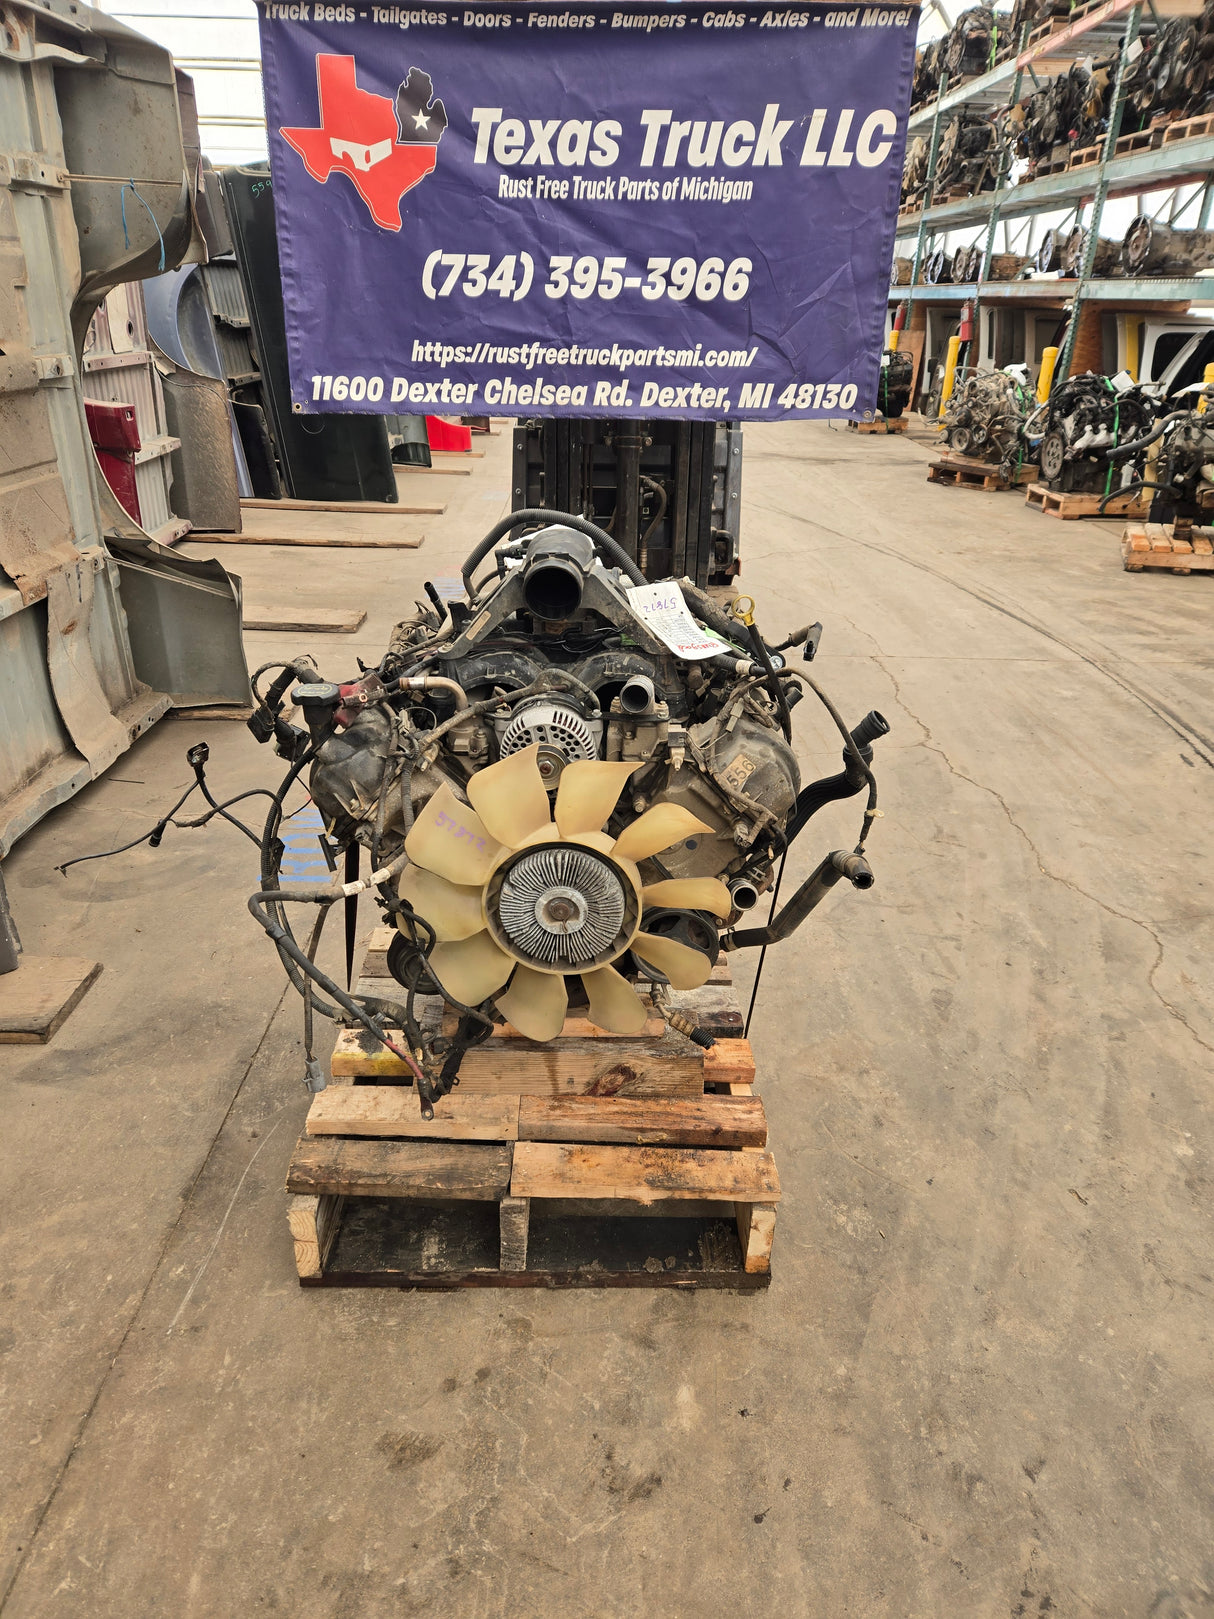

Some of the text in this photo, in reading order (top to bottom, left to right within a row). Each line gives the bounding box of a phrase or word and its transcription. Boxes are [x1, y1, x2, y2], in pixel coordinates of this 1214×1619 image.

[264, 1, 310, 21] Truck
[314, 3, 356, 22] Beds
[372, 6, 447, 29] Tailgates
[463, 11, 512, 28] Doors
[527, 12, 596, 28] Fenders
[611, 12, 687, 32] Bumpers
[702, 10, 746, 28] Cabs
[759, 10, 810, 27] Axles
[824, 8, 860, 27] and
[860, 8, 913, 27] More!
[471, 103, 898, 168] Texas Truck LLC
[498, 173, 754, 204] Rust Free Truck Parts of Michigan
[421, 248, 753, 302] (734) 395-3966
[411, 339, 759, 372] https://rustfreetruckpartsmi.com/
[311, 375, 859, 413] 11600 Dexter Chelsea Rd. Dexter, MI 48130
[434, 810, 486, 854] 57872
